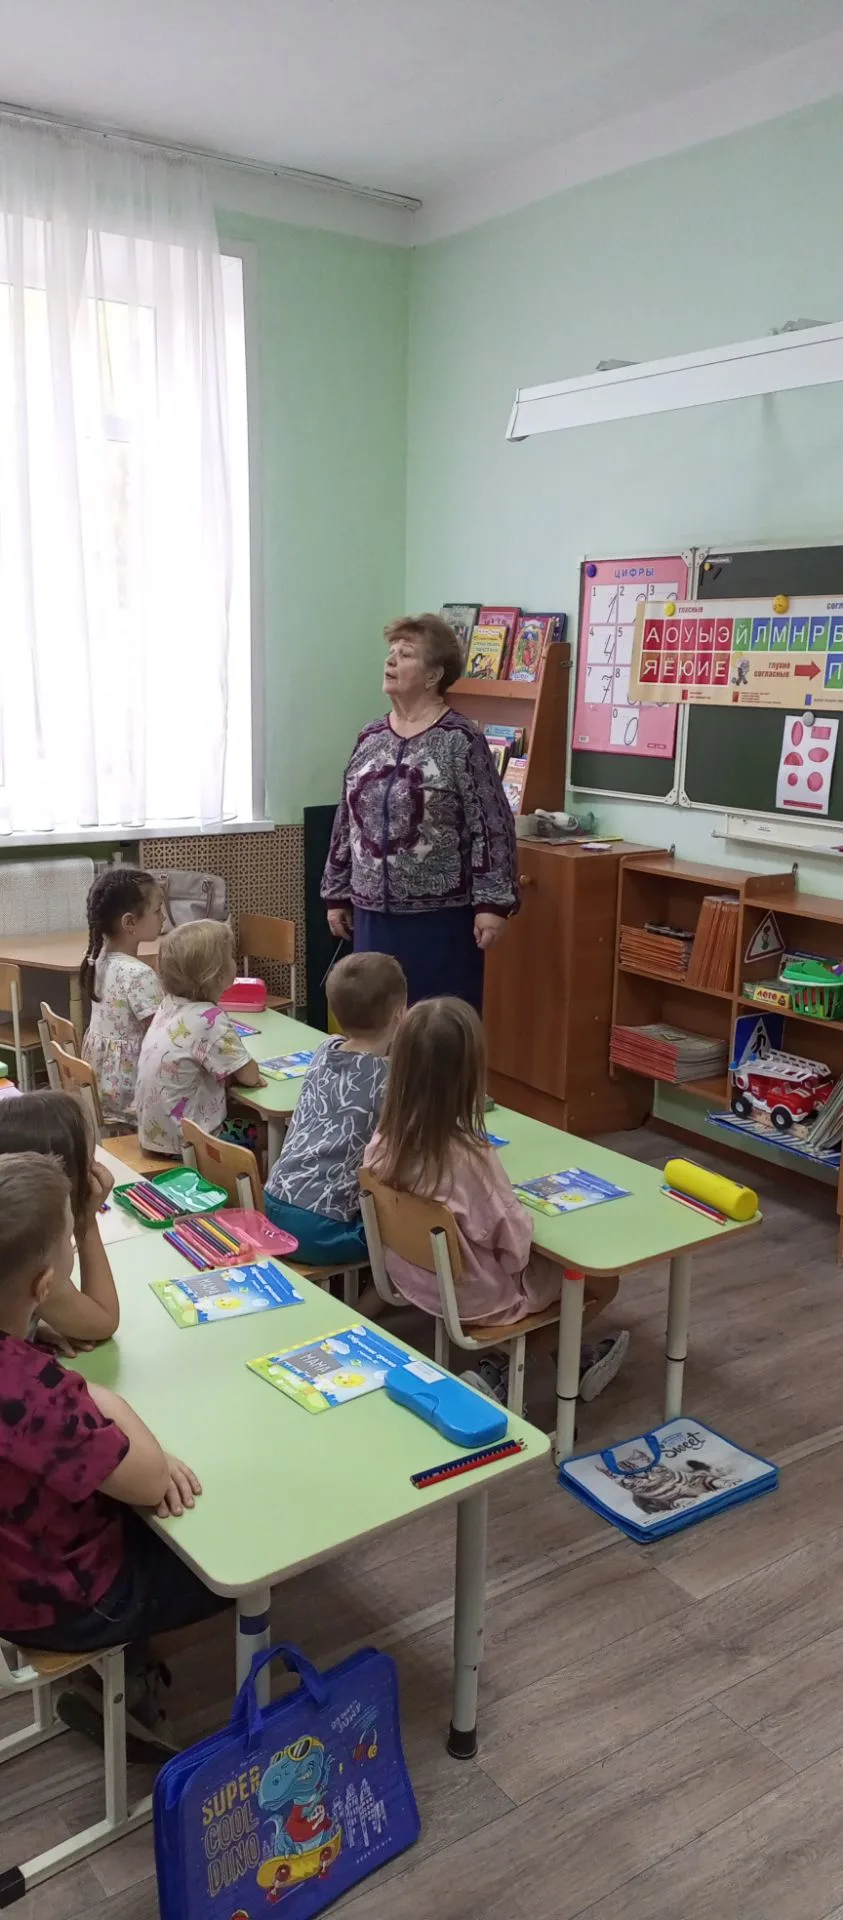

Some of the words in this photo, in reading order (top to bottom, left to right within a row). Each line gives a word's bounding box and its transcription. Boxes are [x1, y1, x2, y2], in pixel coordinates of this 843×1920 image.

[614, 568, 654, 579] ЦИФРЫ
[592, 586, 596, 596] 1
[620, 586, 625, 596] 2
[650, 585, 656, 596] 3
[590, 626, 594, 636] 4
[618, 626, 624, 638] 5
[646, 627, 660, 642] А
[666, 628, 680, 642] О
[680, 627, 694, 642] У
[698, 627, 714, 642] Ы
[717, 627, 730, 642] Э
[735, 625, 748, 643] Й
[754, 626, 768, 642] Л
[772, 626, 786, 642] М
[792, 625, 805, 642] Н
[812, 625, 825, 642] Р
[588, 666, 592, 676] 7
[615, 668, 620, 678] 8
[643, 660, 657, 676] Я
[664, 657, 675, 676] Ё
[678, 660, 694, 676] Ю
[696, 660, 710, 676] И
[714, 660, 726, 677] Е
[828, 662, 842, 680] П
[612, 708, 618, 719] 0
[300, 1352, 333, 1374] МАМА
[660, 1432, 706, 1458] Sweet
[202, 1764, 262, 1826] SUPER
[204, 1799, 260, 1860] COOL
[208, 1832, 260, 1898] DINO
